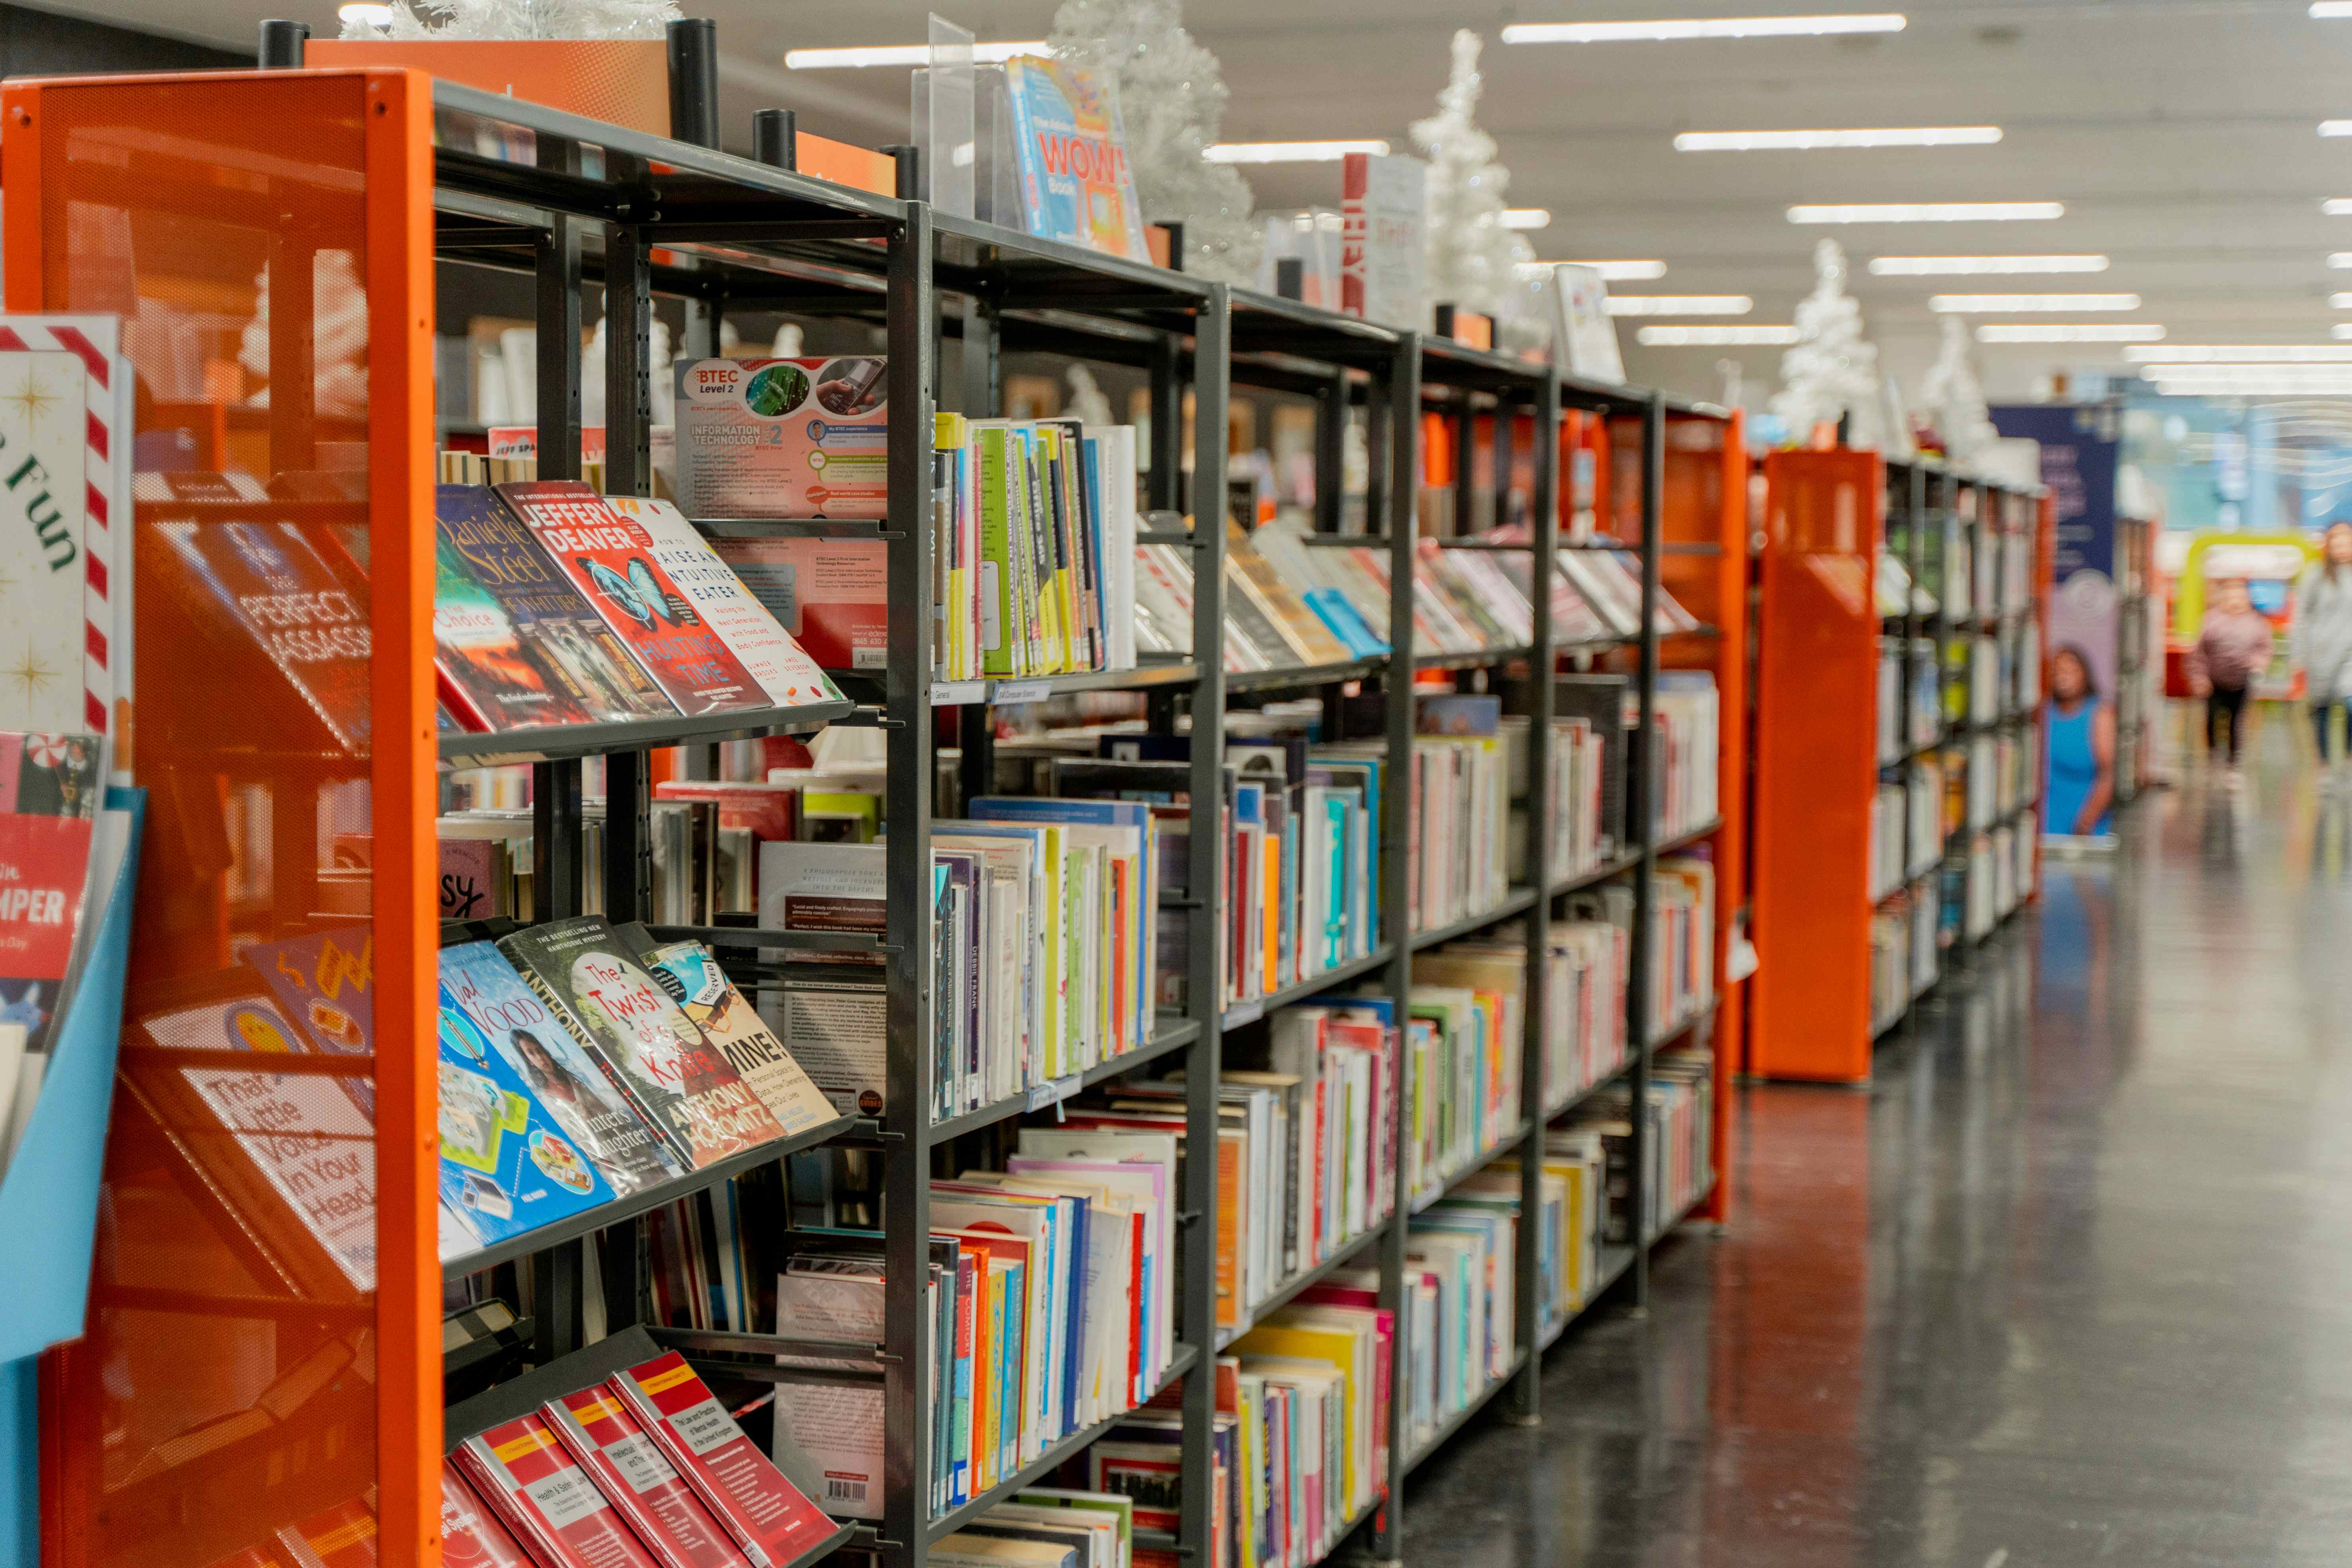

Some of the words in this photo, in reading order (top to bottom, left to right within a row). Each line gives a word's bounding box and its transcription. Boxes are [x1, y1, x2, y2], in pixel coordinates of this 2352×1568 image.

[1037, 130, 1129, 187] WOW!
[697, 370, 738, 383] BTEC
[692, 426, 760, 435] INFORMATION
[695, 436, 760, 445] TECHNOLOGY
[770, 425, 782, 444] 2
[496, 446, 515, 455] JEFF
[6, 453, 76, 573] Fun
[522, 502, 617, 528] JEFFERY
[1032, 479, 1041, 532] Office
[543, 527, 638, 553] DEAVER
[457, 539, 550, 585] Steel
[697, 552, 718, 563] AN
[668, 569, 735, 583] NTUITIVE
[515, 595, 588, 613] WHITTIERS
[692, 586, 739, 600] EATER
[434, 608, 496, 628] Choice
[447, 605, 466, 614] THE
[634, 633, 725, 663] HUNTING
[735, 642, 753, 650] Body
[751, 639, 783, 647] Confidence
[677, 661, 730, 686] TIME
[747, 660, 772, 670] SUMMER
[754, 668, 778, 678] BROOKS
[496, 693, 510, 703] The
[509, 692, 521, 702] final
[536, 935, 552, 945] THE
[550, 926, 589, 941] BESTSELLING
[588, 924, 602, 933] NEW
[547, 940, 584, 953] HAWTHORNE
[583, 933, 607, 945] MYSTERY
[585, 963, 621, 985] The
[701, 964, 715, 1002] RESERVED
[440, 969, 485, 1005] Val
[519, 969, 594, 1049] ANTHONY
[588, 983, 662, 1022] Twist
[639, 1039, 714, 1086] Knife
[752, 1070, 774, 1085] Personal
[774, 1067, 789, 1078] Space
[208, 1074, 273, 1105] That
[788, 1091, 799, 1101] Lives
[668, 1081, 751, 1128] ANTHONY
[232, 1099, 302, 1135] Little
[681, 1103, 774, 1151] HOROWITZ
[576, 1128, 651, 1161] Daughter
[305, 1152, 363, 1187] Your
[302, 1183, 377, 1225] Head
[675, 1418, 685, 1427] The
[701, 1405, 716, 1417] Practice
[695, 1423, 707, 1432] Mental
[707, 1417, 720, 1427] Health
[705, 1433, 716, 1443] United
[715, 1426, 733, 1438] Kingdom
[960, 1430, 968, 1457] Haig
[551, 1417, 586, 1459] STRAIGHTFORWARD
[583, 1457, 596, 1471] GUIDE
[598, 1475, 623, 1506] INTELLECTUAL
[610, 1444, 636, 1460] Intellectual
[627, 1459, 636, 1469] and
[635, 1456, 646, 1465] The
[466, 1460, 502, 1503] STRAIGHTFORWARD
[499, 1501, 513, 1516] GUIDE
[535, 1488, 555, 1502] Health
[560, 1480, 577, 1494] Safet
[576, 1475, 587, 1485] Law
[447, 1512, 477, 1533] System
